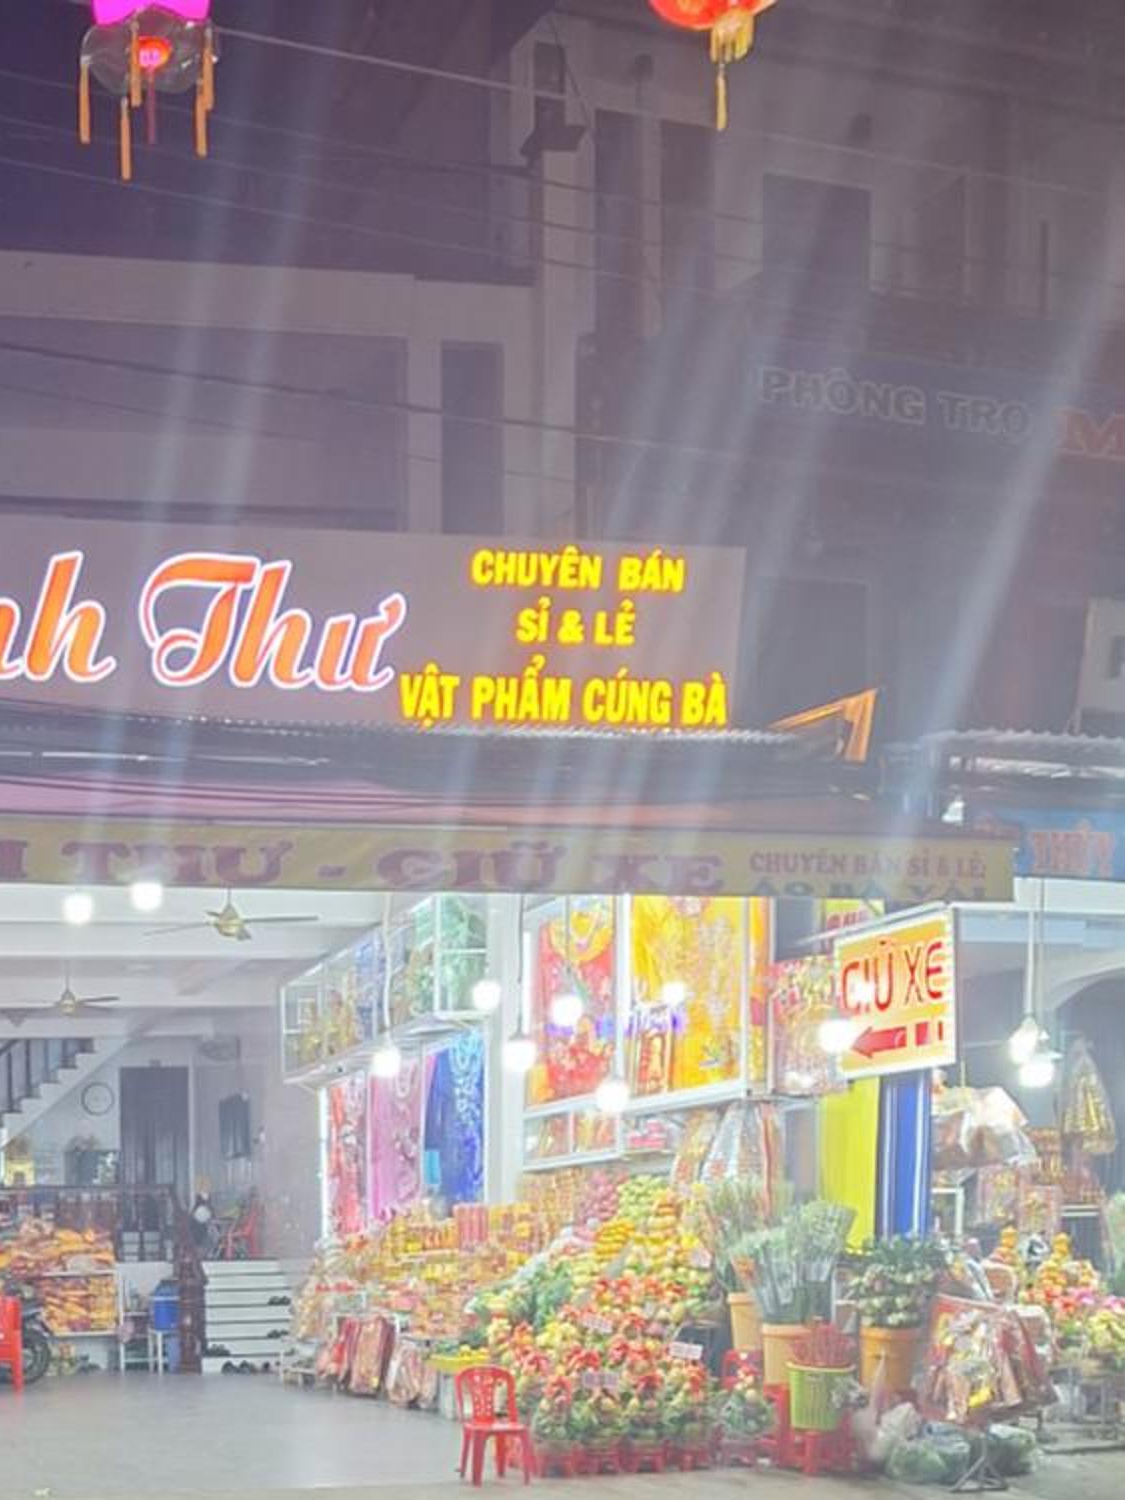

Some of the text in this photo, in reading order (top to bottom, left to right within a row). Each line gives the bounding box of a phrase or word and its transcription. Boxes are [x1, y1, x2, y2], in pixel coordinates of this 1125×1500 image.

[471, 544, 686, 593] CHUYÊN BÁN
[140, 552, 406, 692] Thư
[516, 596, 637, 646] SỈ & LẺ
[400, 654, 729, 729] VẬT PHẨM CÚNG BÀ
[61, 839, 294, 883] THƯ
[590, 853, 725, 894] XE
[904, 940, 944, 1005] XE
